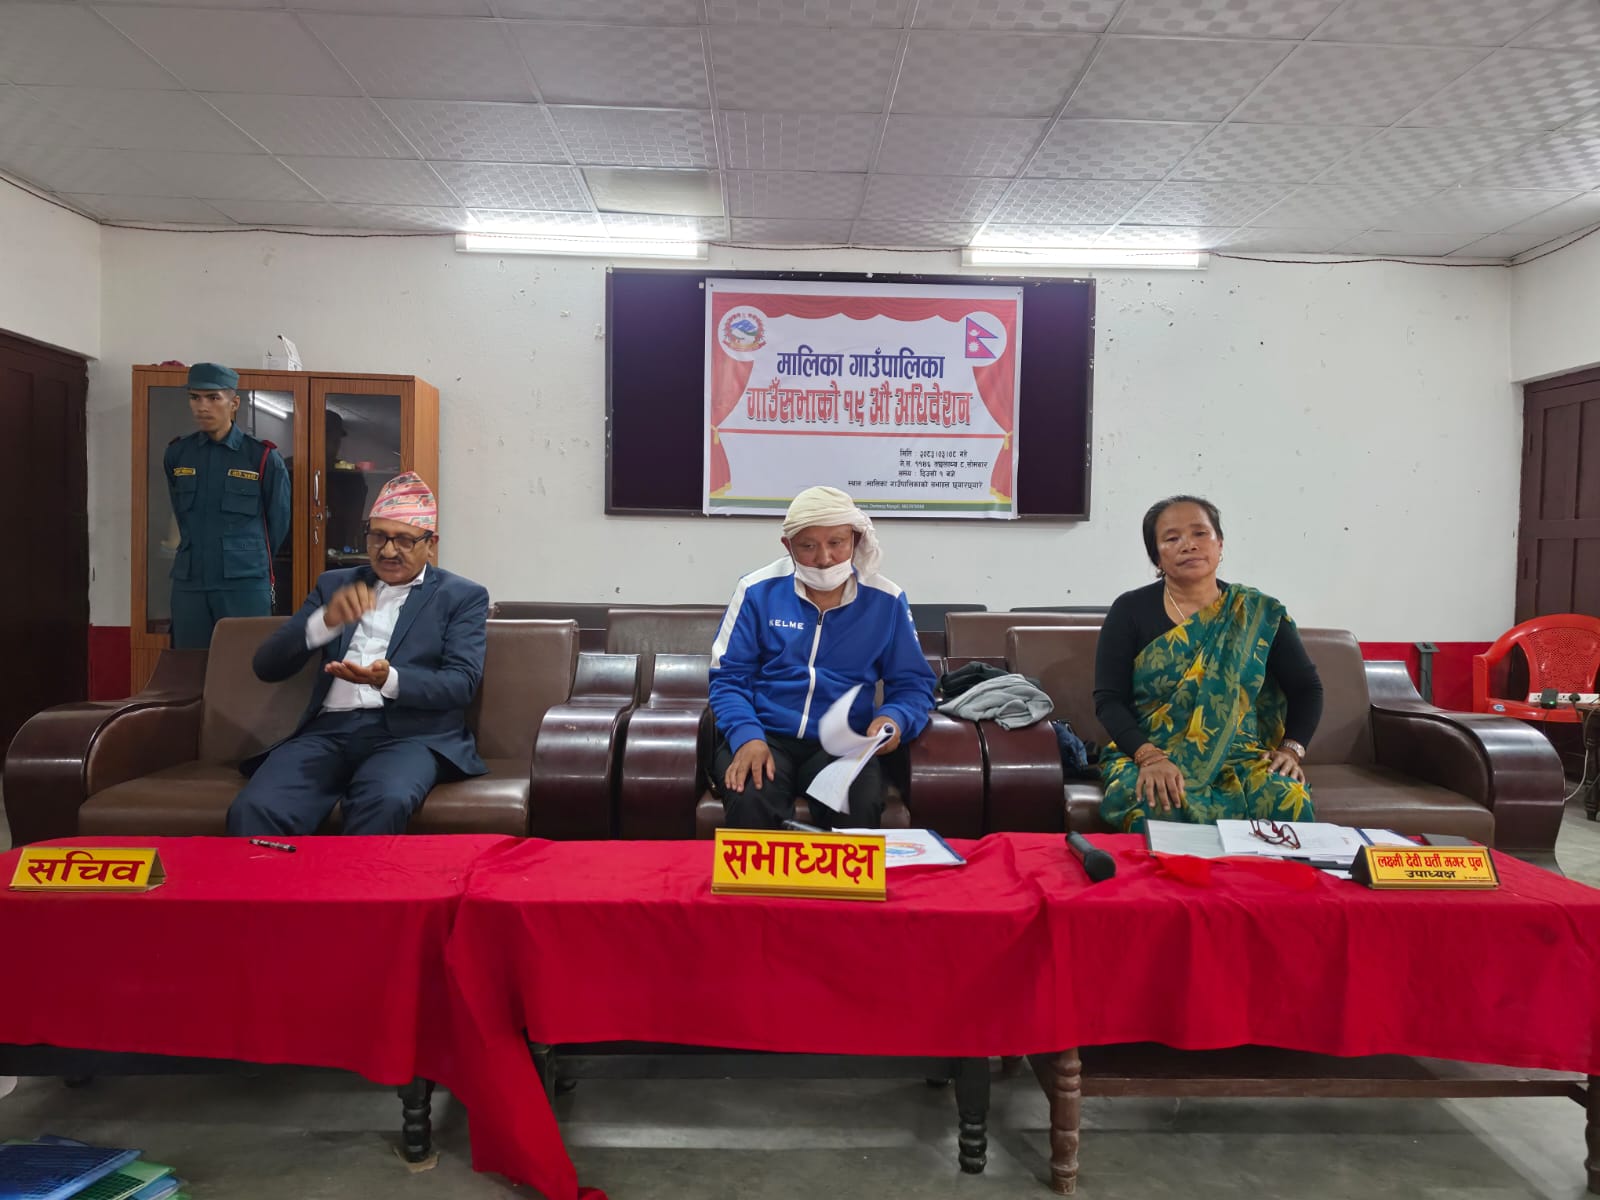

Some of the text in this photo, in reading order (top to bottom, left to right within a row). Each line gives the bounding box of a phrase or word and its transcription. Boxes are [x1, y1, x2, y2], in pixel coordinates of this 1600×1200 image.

[777, 344, 945, 379] मालिका गाउँपालिका
[746, 377, 841, 423] गाउँसभाको
[895, 383, 974, 428] अधिवेशन
[769, 619, 804, 630] KELME
[27, 850, 146, 885] सचिव
[722, 839, 880, 884] सभाध्यक्ष
[1376, 853, 1403, 868] लक्ष्मी
[1405, 853, 1422, 868] देवी
[1443, 856, 1466, 869] मगर
[1468, 856, 1484, 871] पुन
[1404, 869, 1457, 879] उपाध्यक्ष
